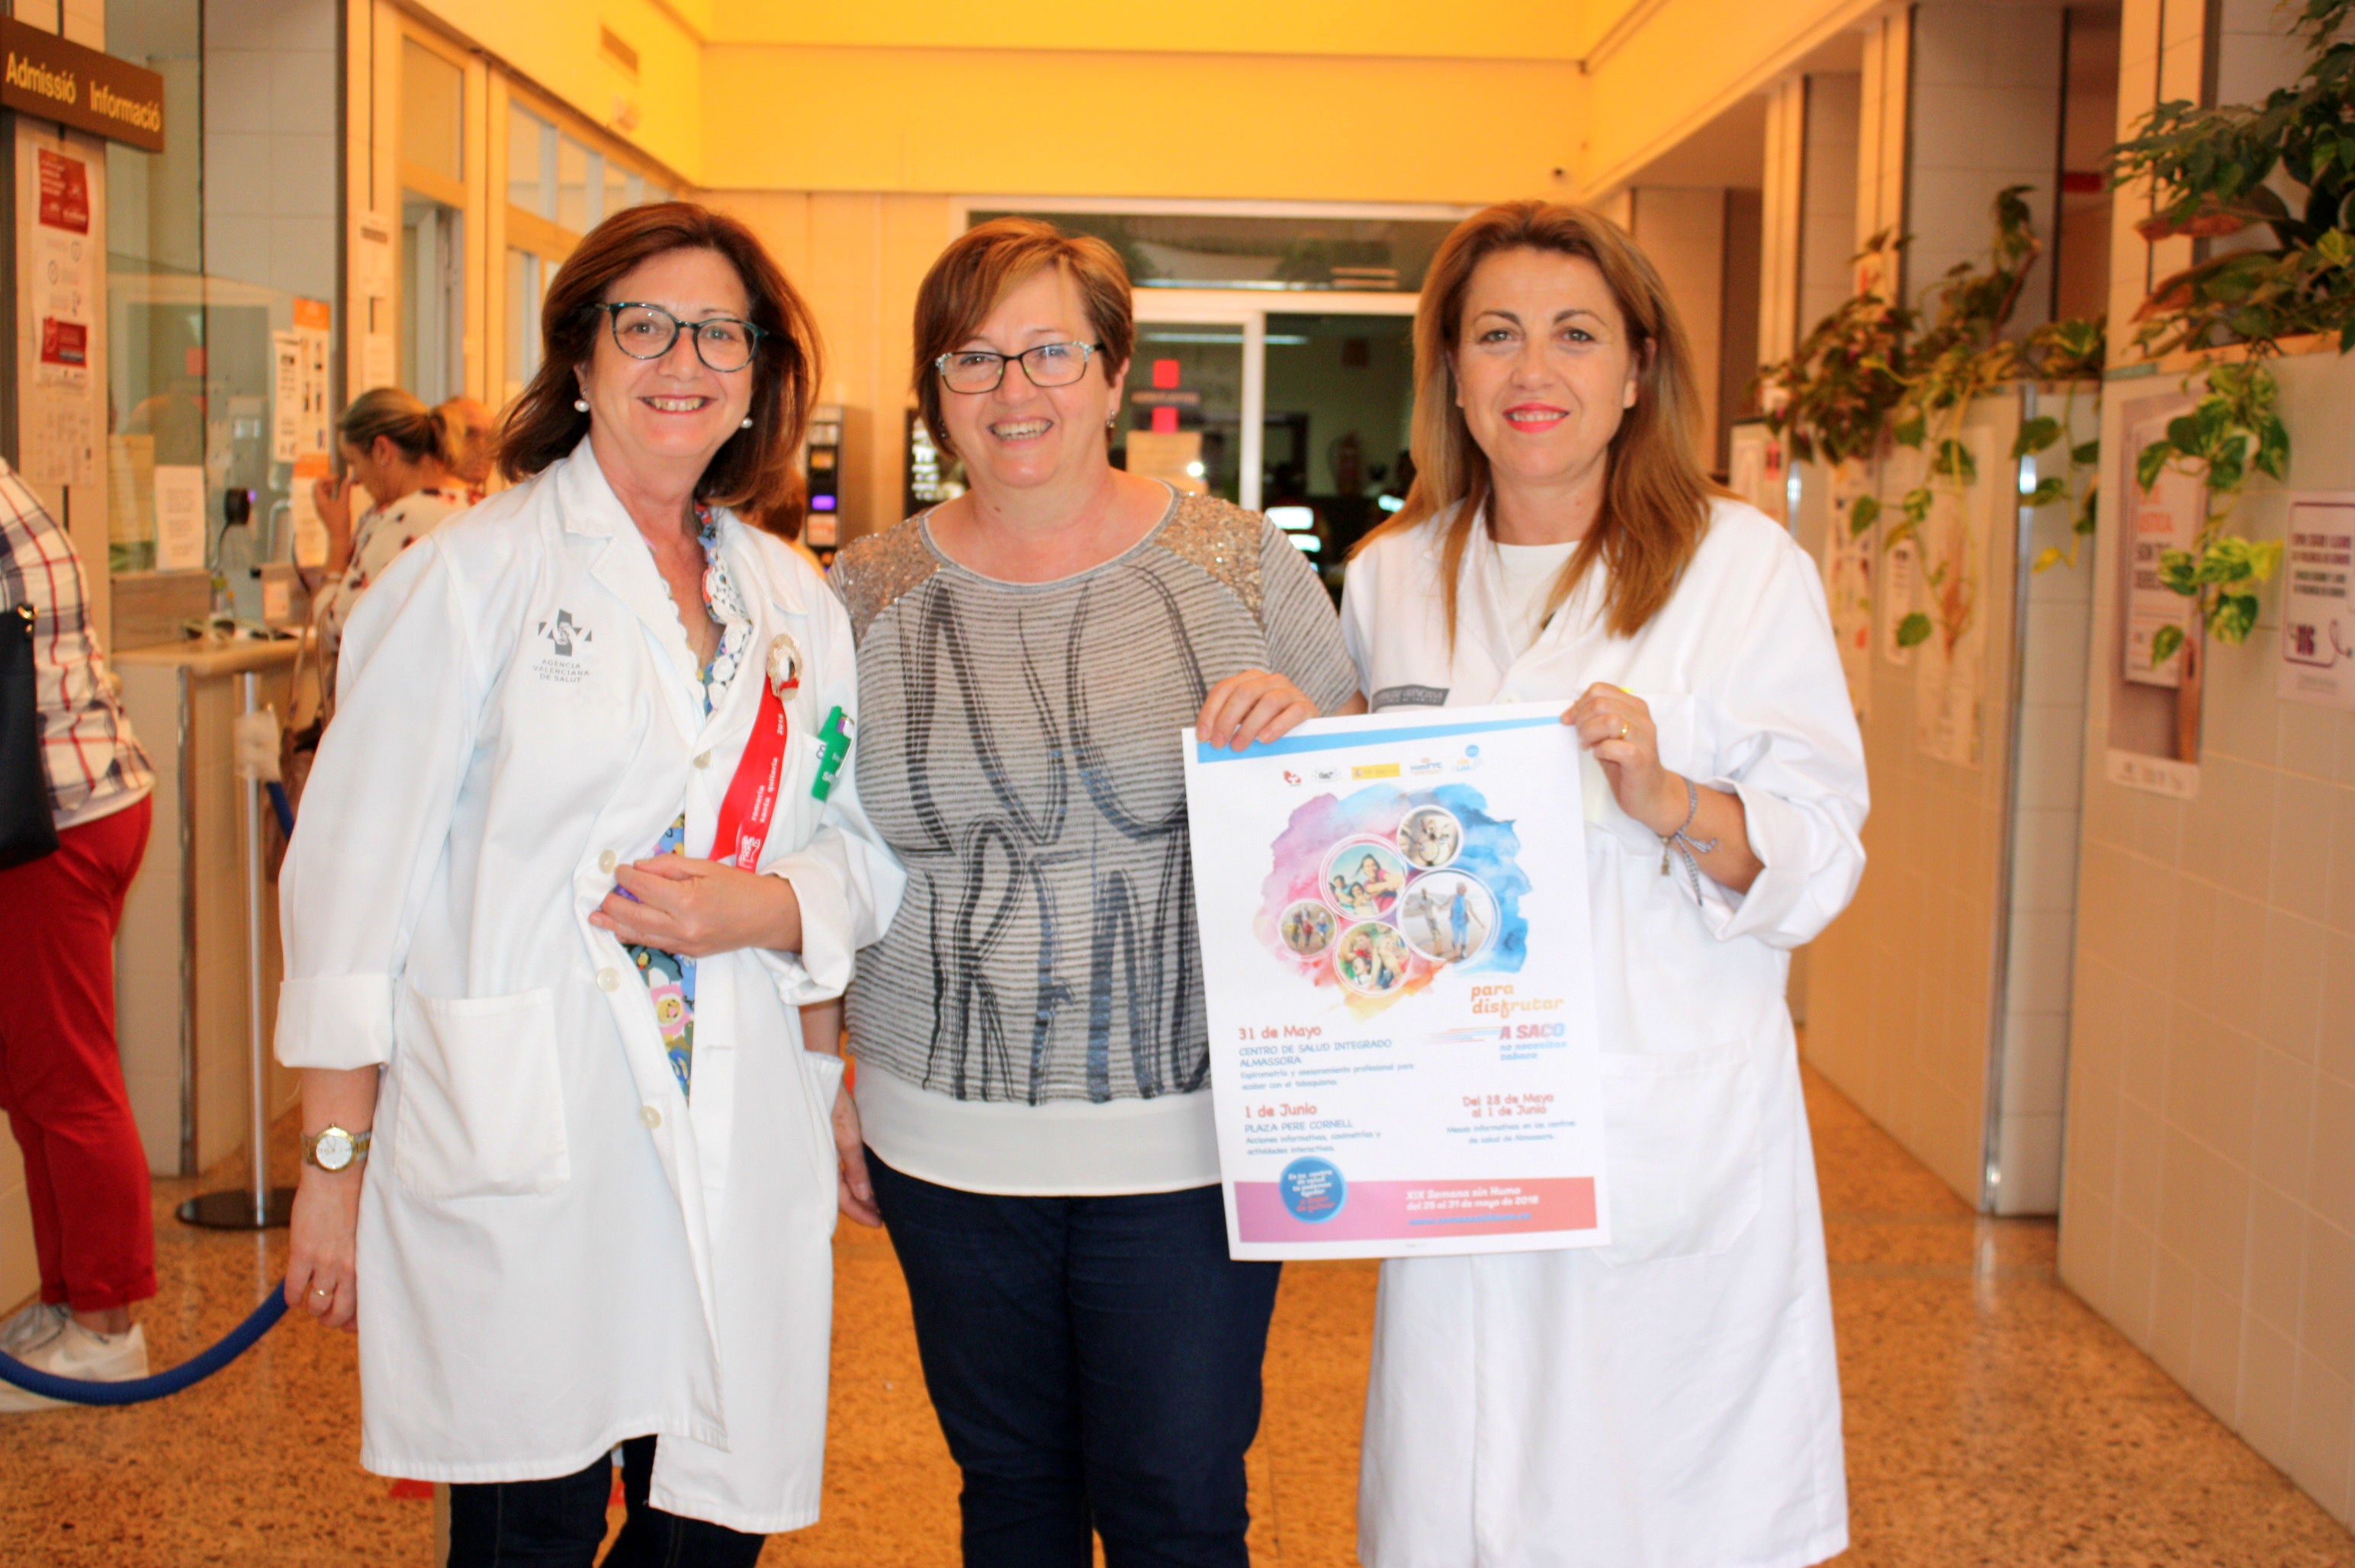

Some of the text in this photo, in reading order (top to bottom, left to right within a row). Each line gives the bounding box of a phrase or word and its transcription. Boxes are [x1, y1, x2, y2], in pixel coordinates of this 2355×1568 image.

[5, 51, 161, 133] Admissió Informació
[533, 665, 589, 676] VALENCIANA
[554, 675, 581, 683] SALUT
[760, 757, 778, 824] santa quiteria
[1470, 985, 1514, 1001] para
[1473, 998, 1564, 1019] disfrutar
[1239, 1024, 1322, 1040] 31 de Mayo
[1499, 1023, 1566, 1040] A SACO
[1239, 1039, 1392, 1057] CENTRO DE SALUD INTEGRADO
[1240, 1057, 1301, 1068] ALMASSORA
[1463, 1096, 1480, 1107] Del
[1505, 1093, 1518, 1104] de
[1523, 1093, 1554, 1104] Mayo
[1245, 1102, 1317, 1118] 1 de Junio
[1472, 1107, 1482, 1117] al
[1498, 1106, 1512, 1116] de
[1516, 1104, 1547, 1115] Junio
[1245, 1120, 1354, 1133] PLAZA PERE CORNELL
[1427, 1188, 1470, 1199] Semana
[1472, 1187, 1487, 1197] sin
[1460, 1198, 1473, 1208] de
[1474, 1199, 1499, 1209] mayo
[1501, 1197, 1513, 1206] de
